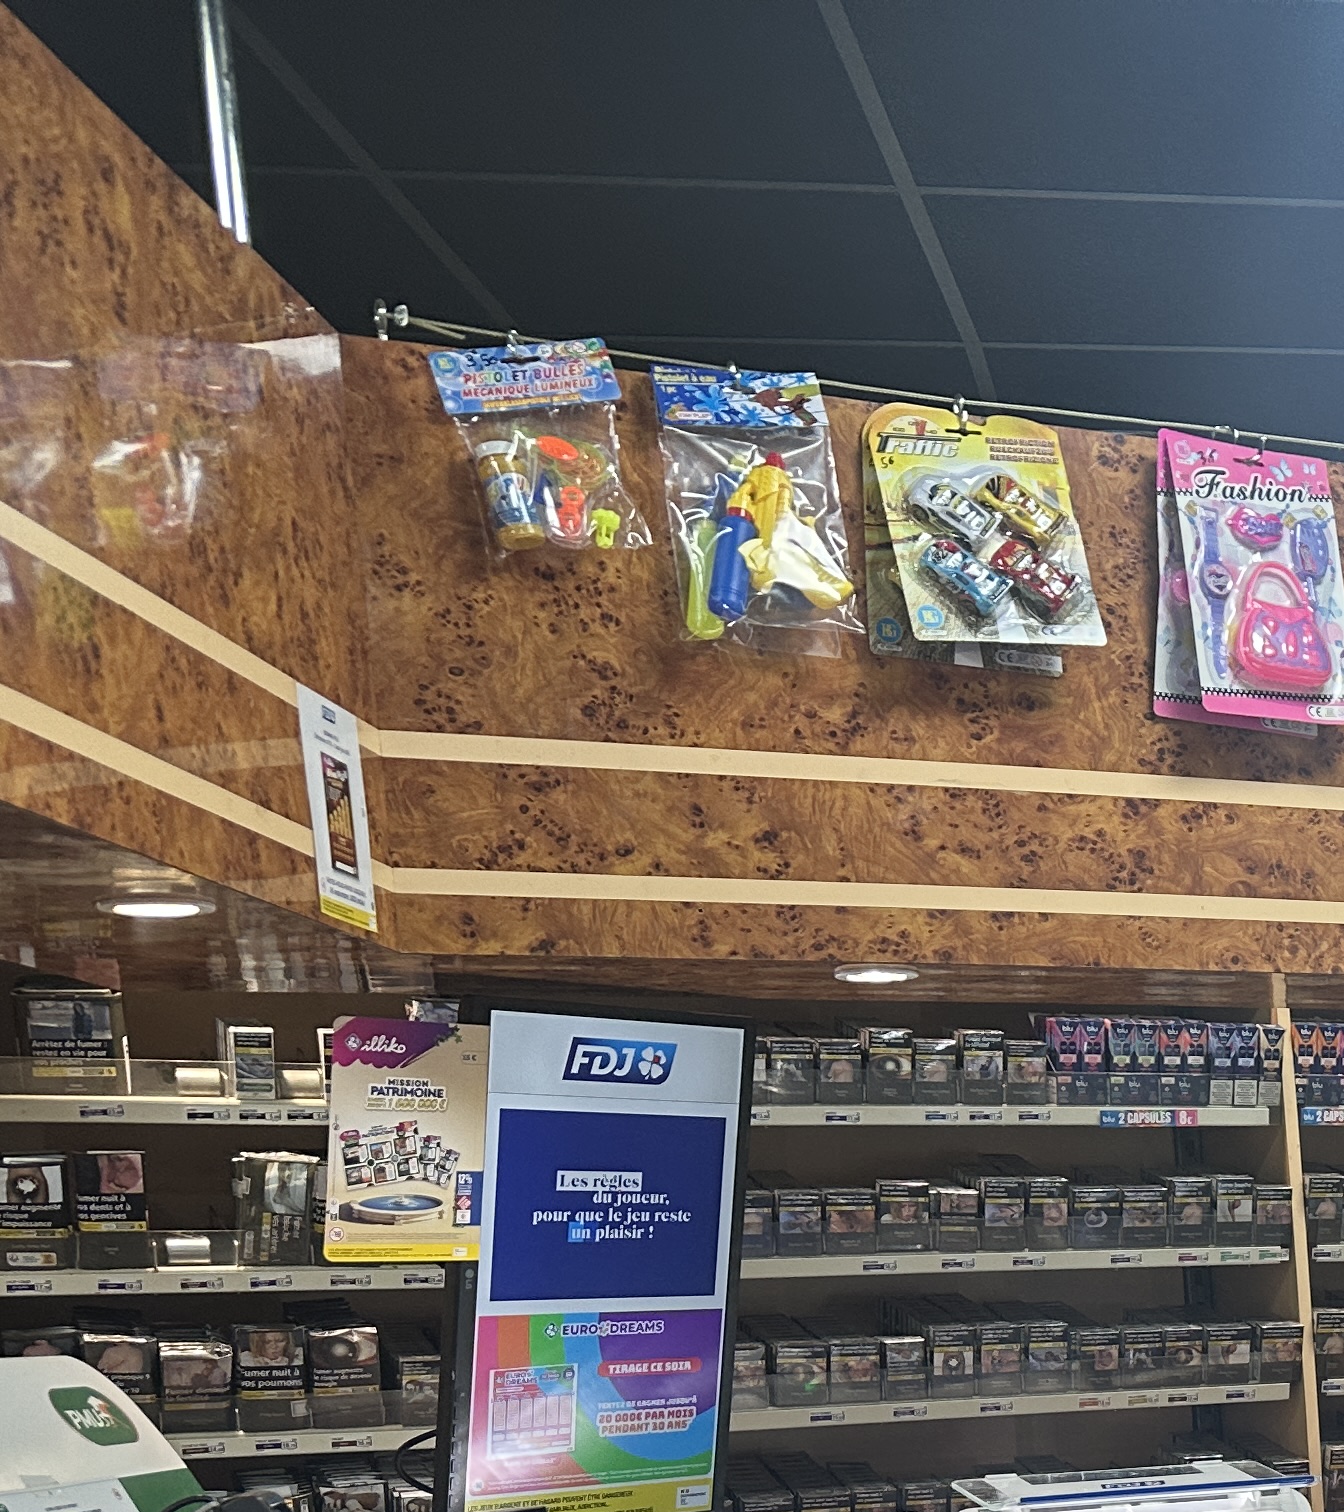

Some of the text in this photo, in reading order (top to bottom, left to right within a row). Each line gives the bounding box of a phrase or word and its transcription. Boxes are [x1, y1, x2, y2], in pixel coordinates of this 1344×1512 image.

[463, 363, 585, 385] PISTOLET BULLES
[461, 377, 594, 398] MECANIQUE LUMINEUX
[875, 431, 963, 459] Traffic
[1193, 468, 1307, 503] Fashion
[360, 1034, 407, 1055] illiko
[570, 1044, 634, 1078] FDJ
[370, 1085, 445, 1099] PATRIMOINE
[387, 1078, 430, 1088] MISSION
[1118, 1110, 1172, 1125] 2 CAPSULES
[560, 1173, 641, 1193] Les règles
[593, 1191, 613, 1204] du
[533, 1207, 692, 1227] pour que le jeu reste
[571, 1224, 645, 1243] un plaisir
[562, 1321, 664, 1336] EURO DREAMS
